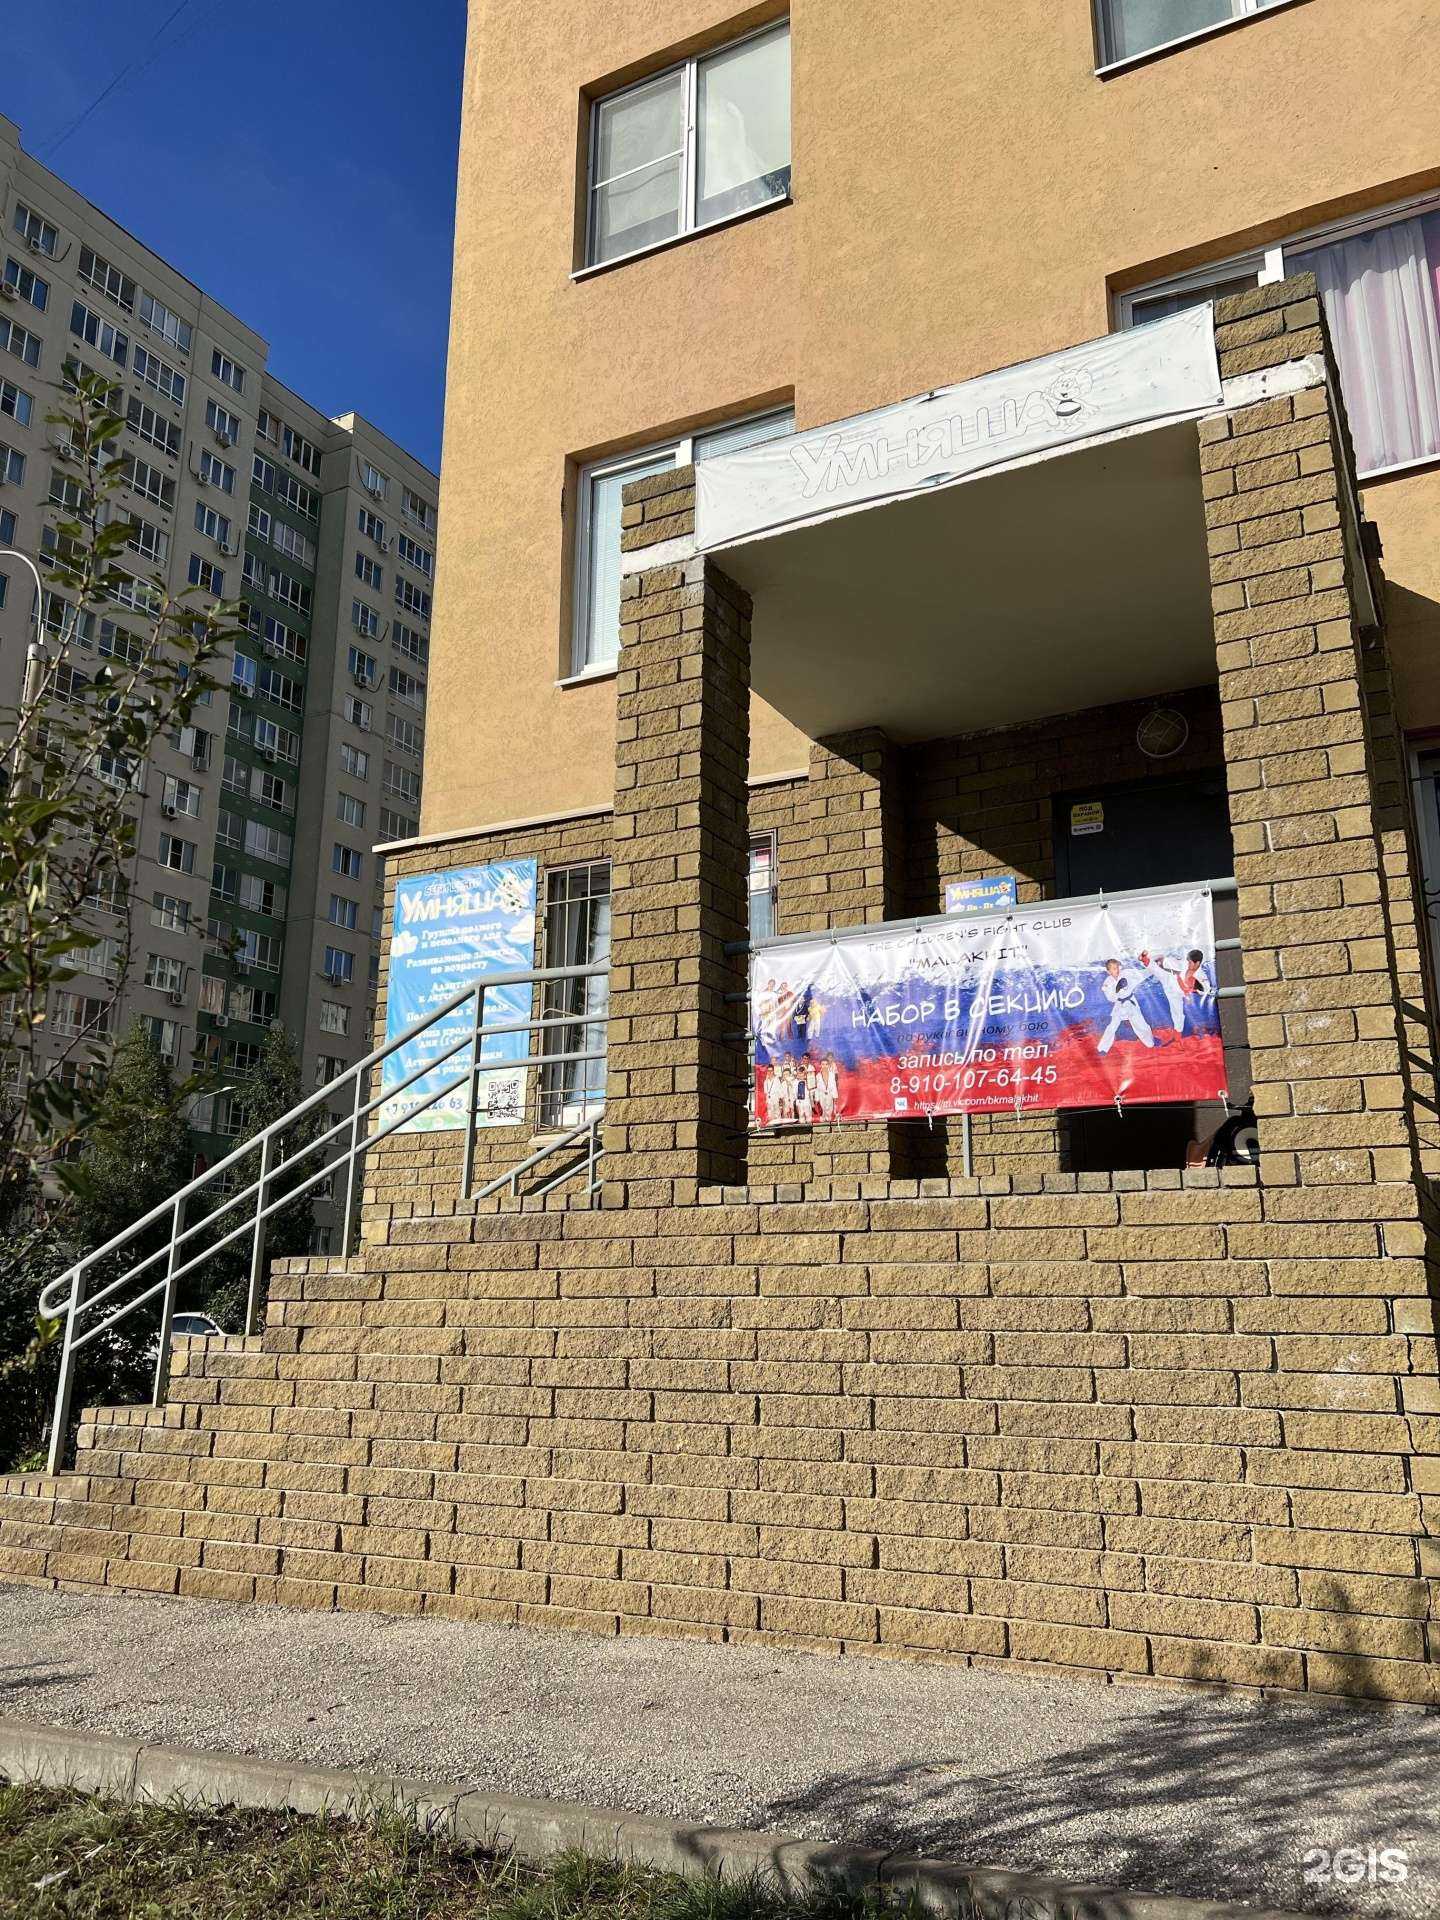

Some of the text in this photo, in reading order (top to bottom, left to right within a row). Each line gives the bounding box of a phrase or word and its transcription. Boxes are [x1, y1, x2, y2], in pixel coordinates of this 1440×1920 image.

[789, 390, 1056, 499] УМНЯША
[867, 938, 894, 951] THE
[897, 928, 979, 949] CHILDREN'S
[1032, 917, 1073, 931] CLUB
[851, 986, 1085, 1029] НАБОР В СЕКЦИЮ
[897, 1044, 1053, 1070] запись по тел.
[889, 1065, 1058, 1095] 8-910-107-64-45
